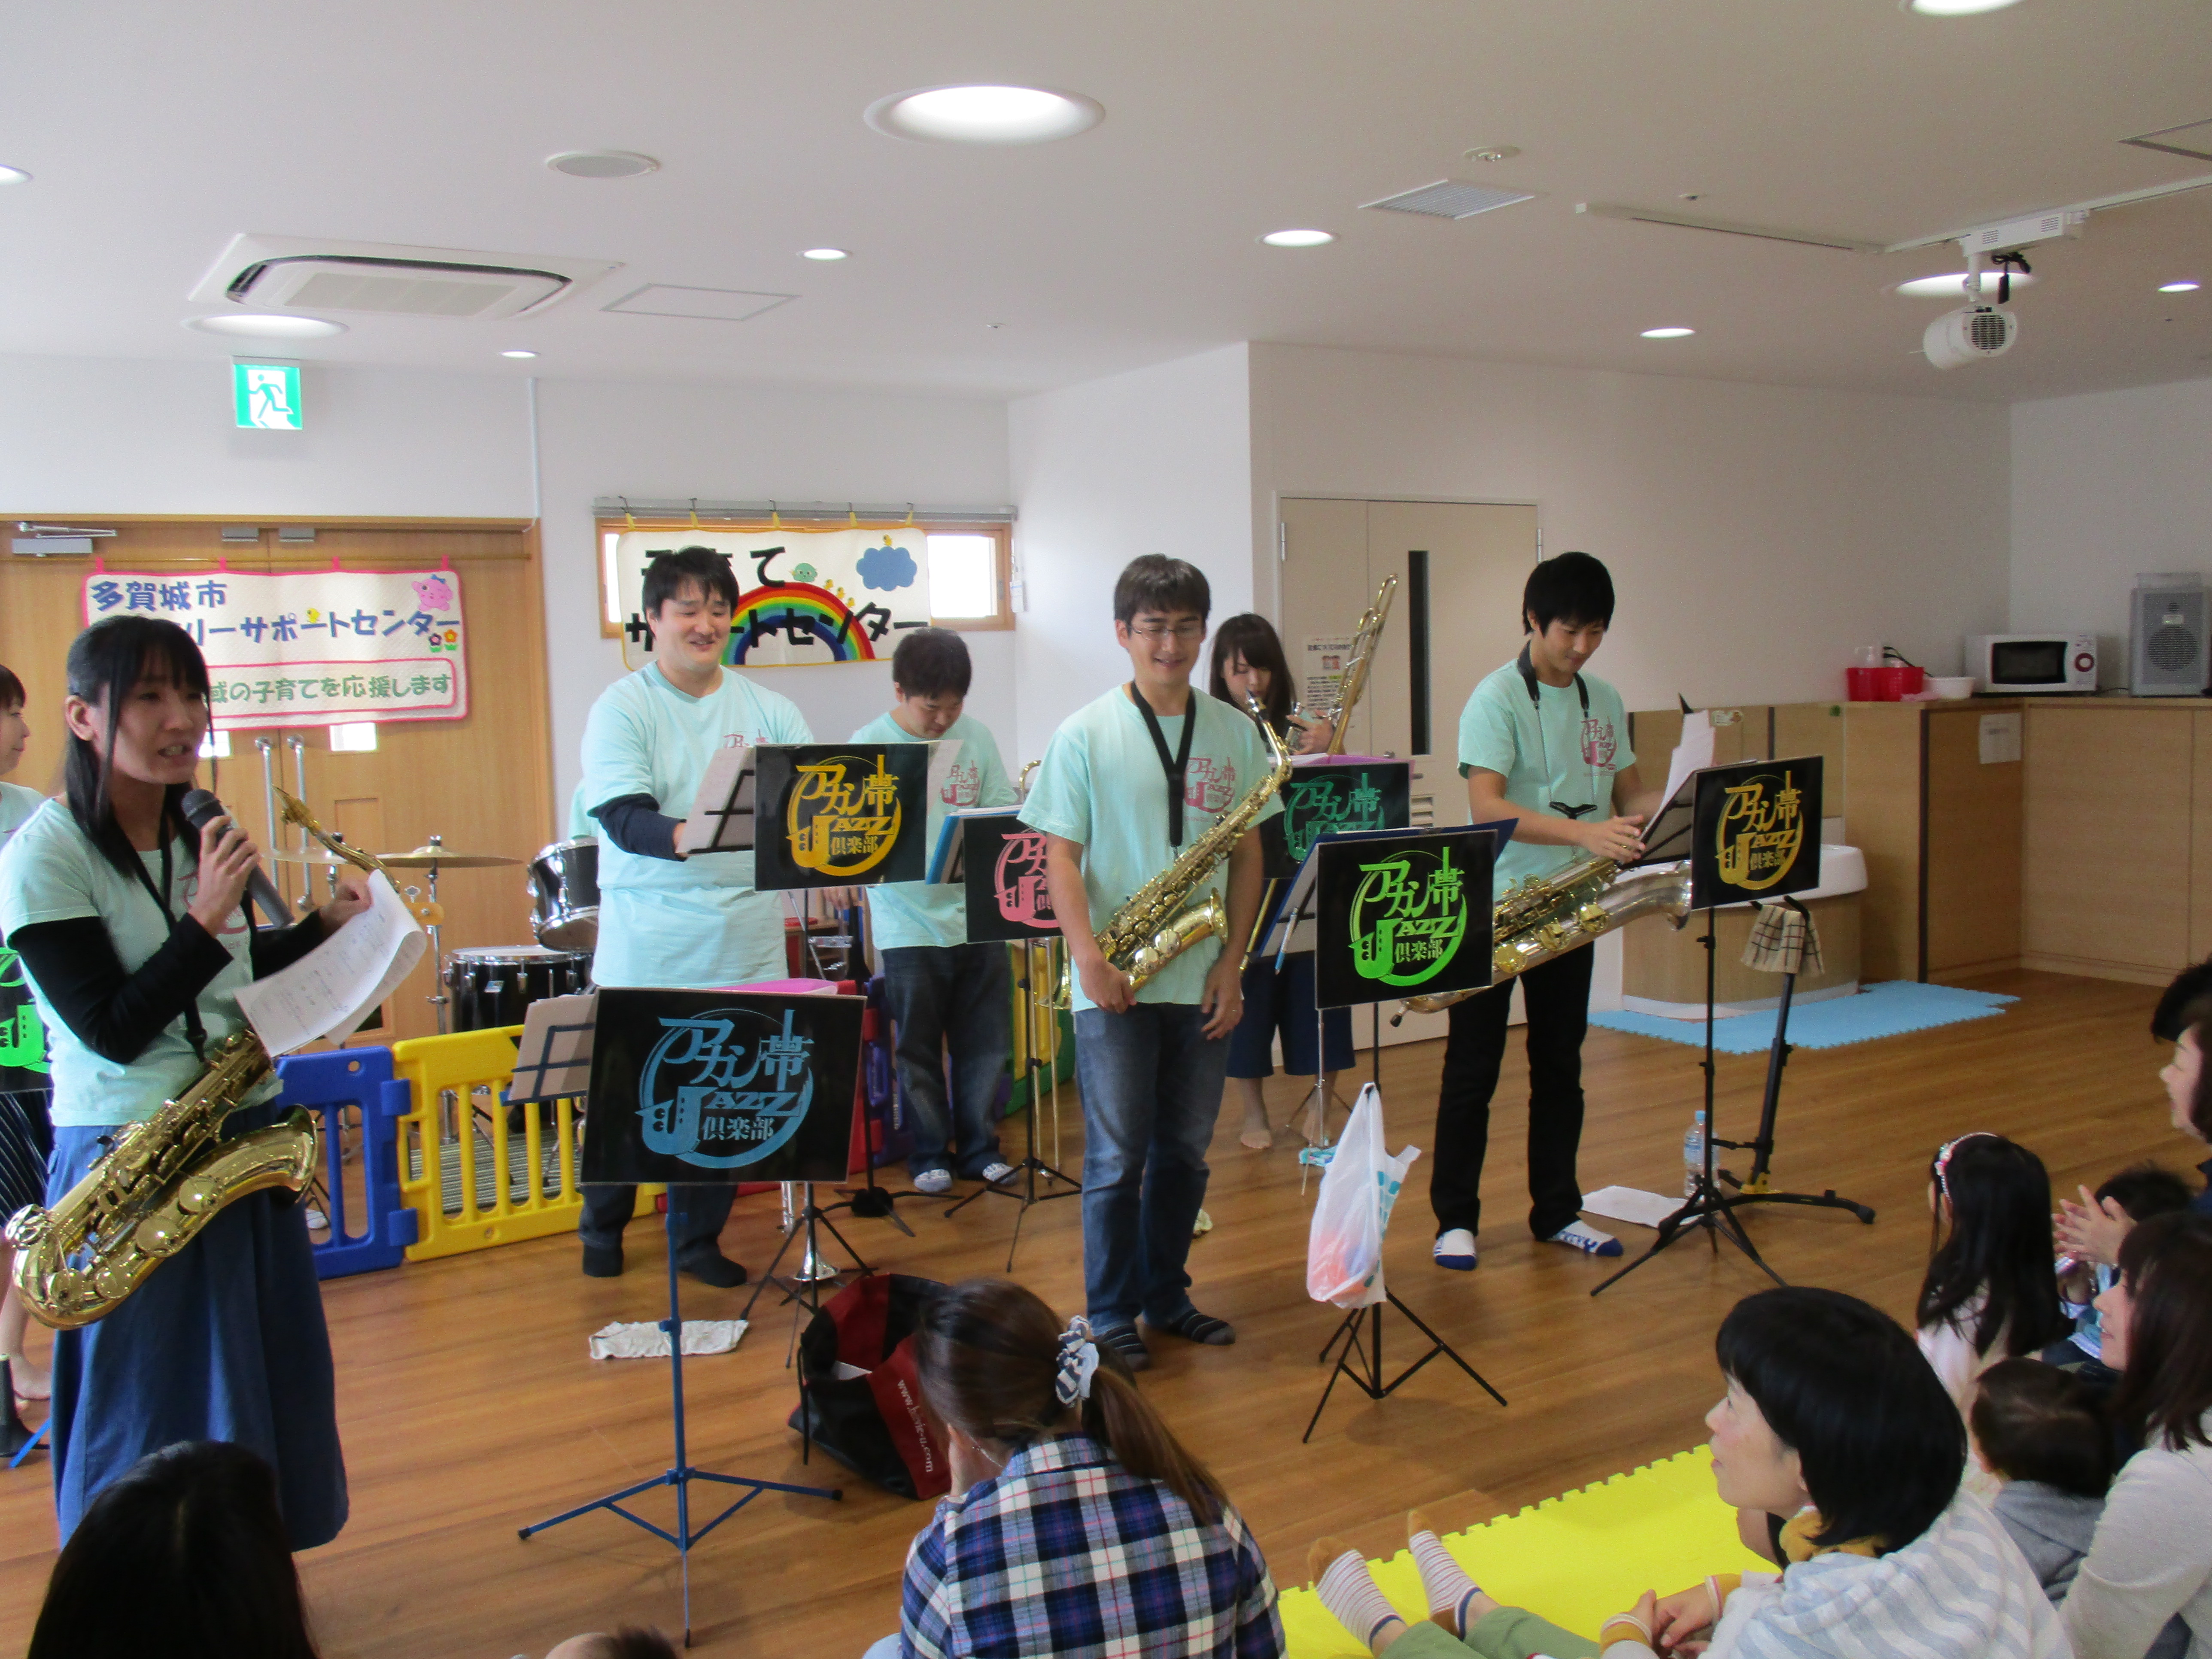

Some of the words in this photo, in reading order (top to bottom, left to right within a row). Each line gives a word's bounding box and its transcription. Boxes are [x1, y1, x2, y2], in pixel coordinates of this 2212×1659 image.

[91, 580, 228, 612] 多賀城市
[177, 609, 460, 646] リーサポートセンター
